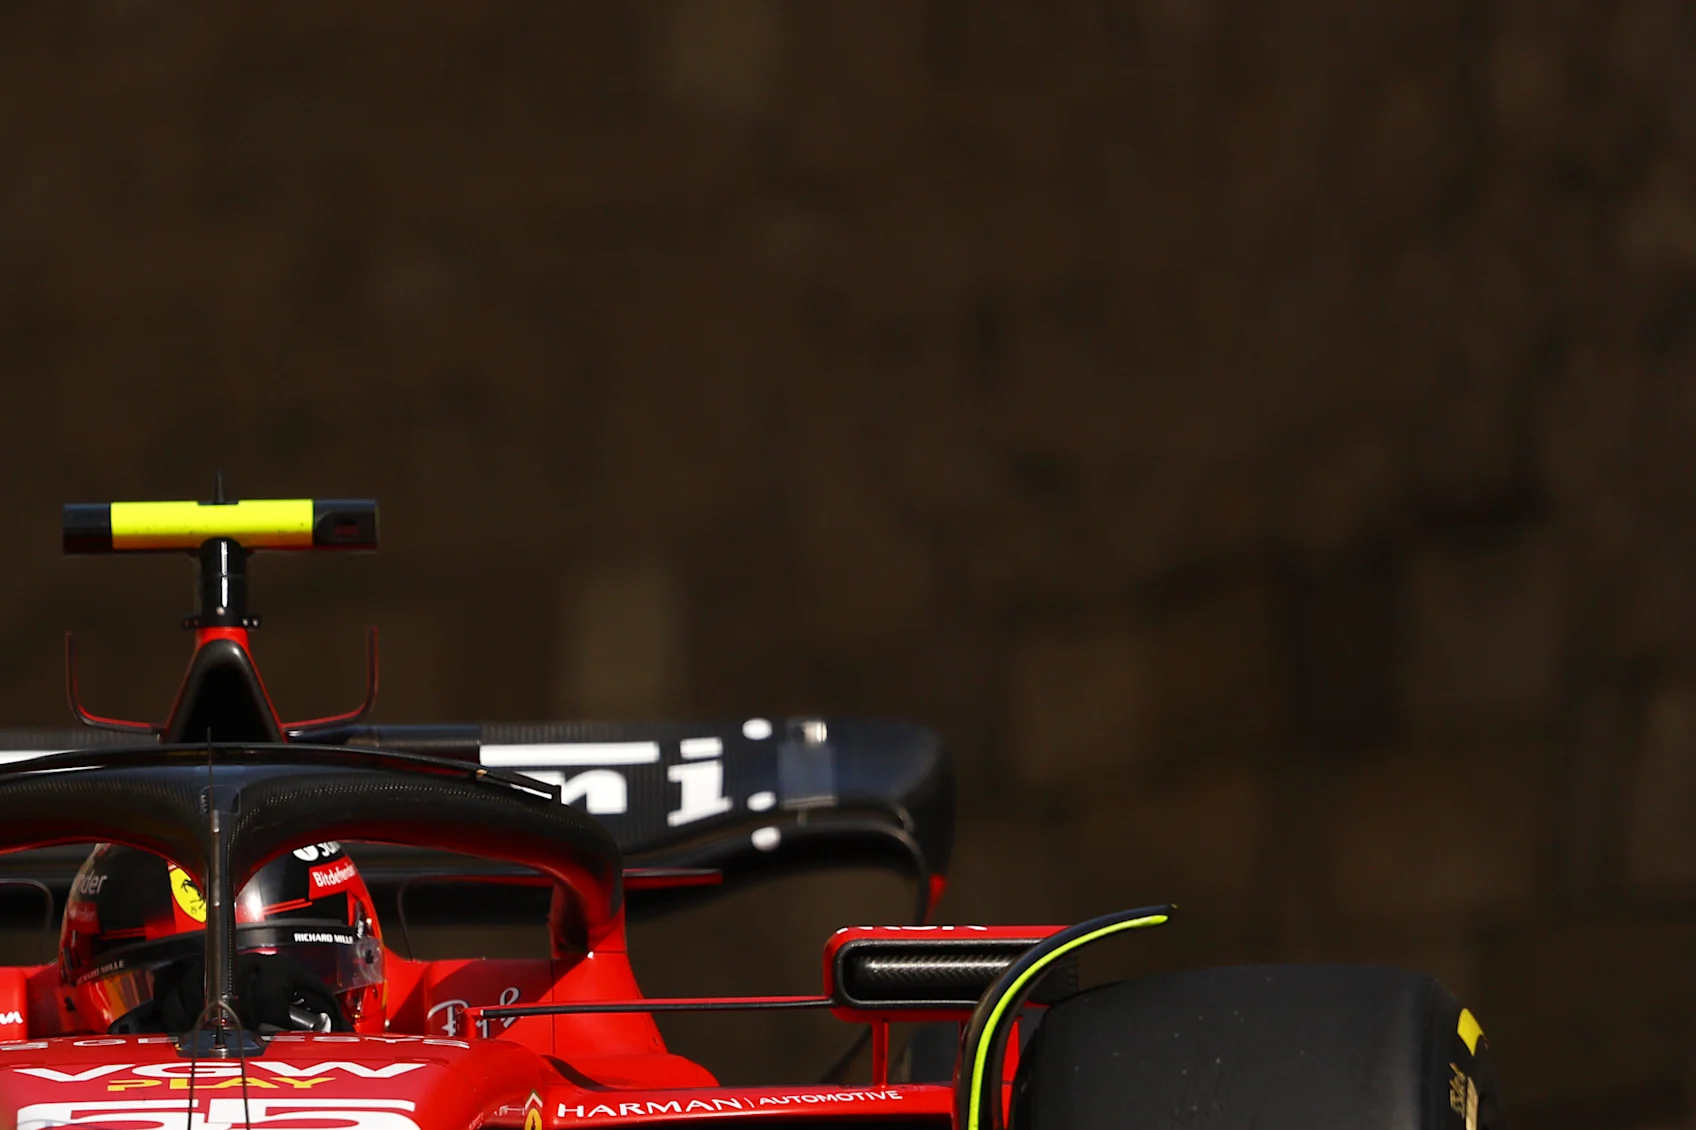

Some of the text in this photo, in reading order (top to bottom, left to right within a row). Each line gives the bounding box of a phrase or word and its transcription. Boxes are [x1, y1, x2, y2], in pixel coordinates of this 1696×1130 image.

[294, 933, 333, 943] RICHARD
[14, 1061, 429, 1083] VGW
[107, 1076, 336, 1093] PLAY
[557, 1090, 904, 1118] HARMAN AUTOMOTIVE
